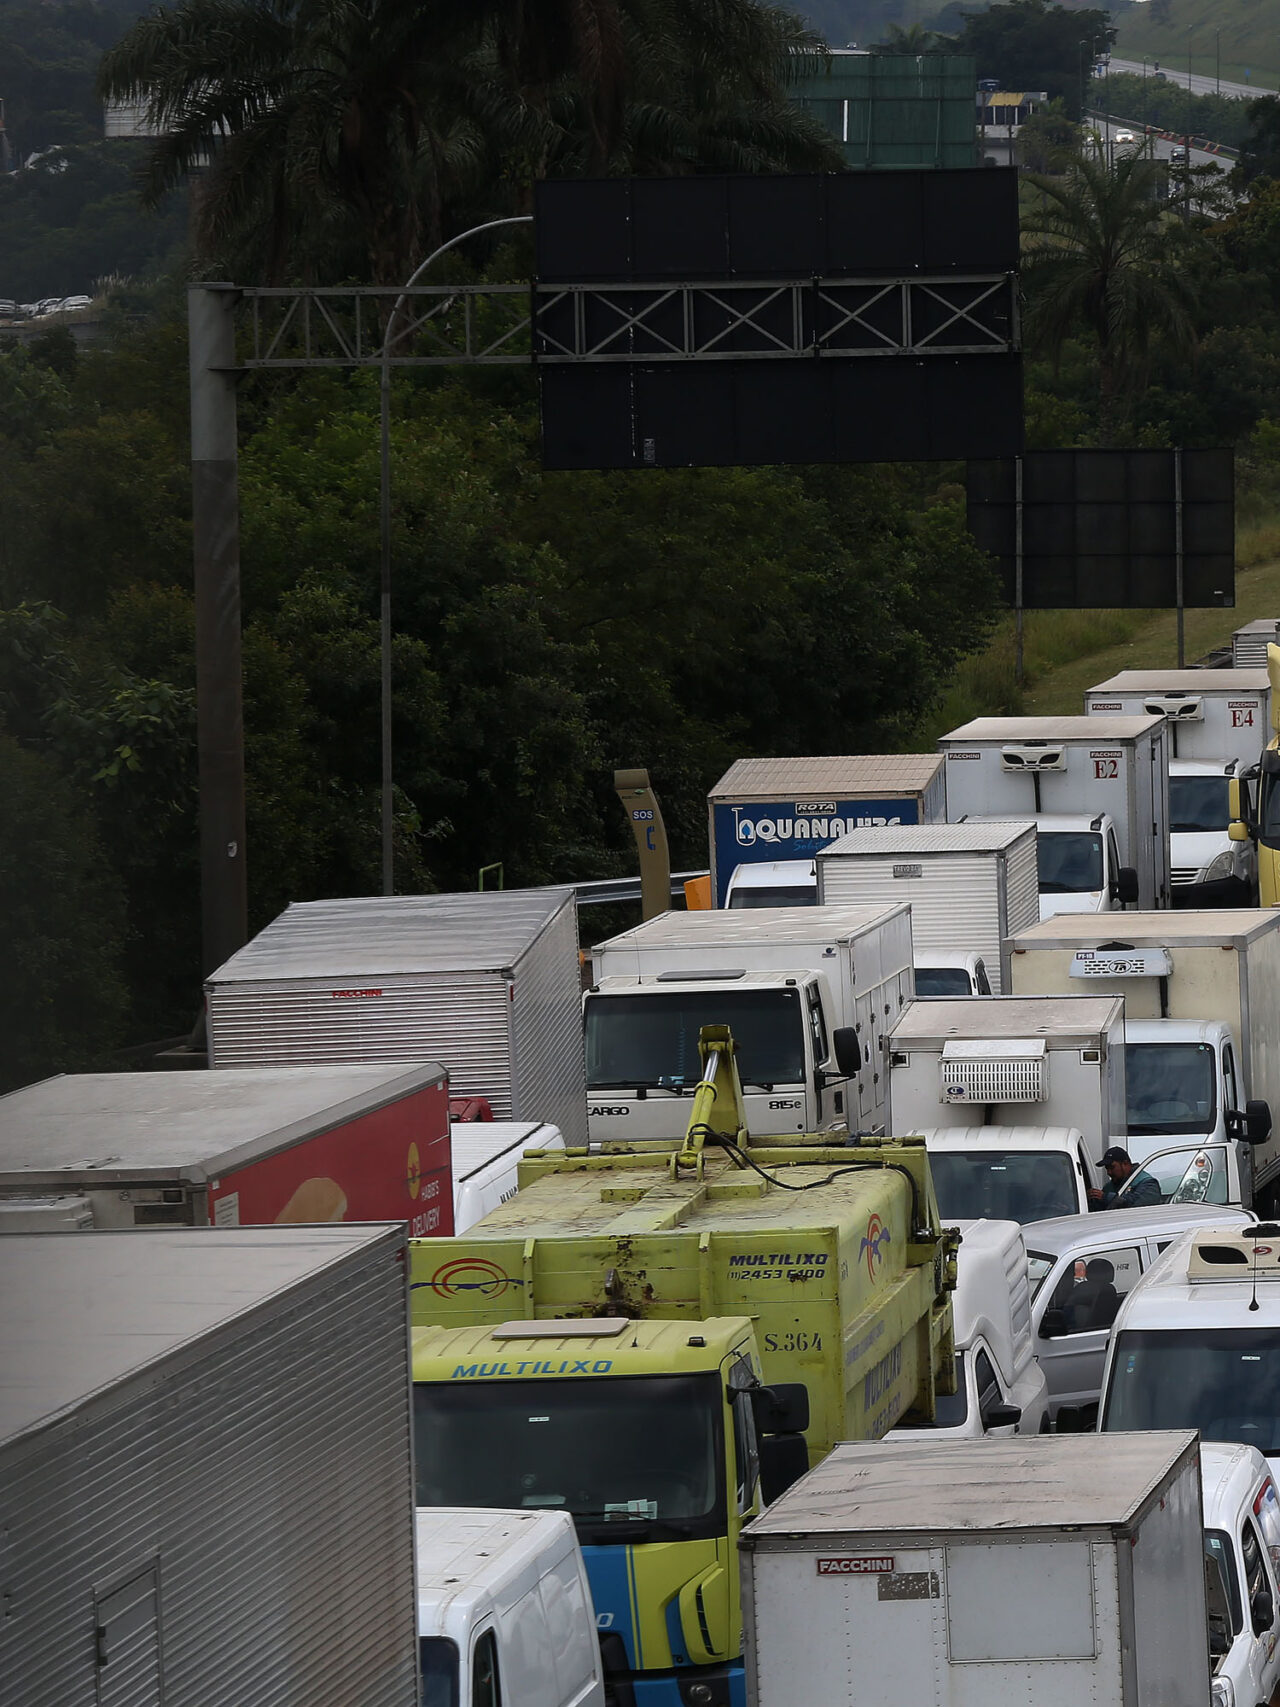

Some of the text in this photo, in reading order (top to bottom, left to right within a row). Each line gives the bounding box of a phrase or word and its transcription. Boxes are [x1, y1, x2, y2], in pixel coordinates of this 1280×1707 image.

[1231, 709, 1254, 727] E4
[1094, 759, 1118, 779] E2
[798, 803, 835, 811] ROTA
[633, 810, 653, 819] SOS
[587, 1106, 630, 1116] CARGO
[729, 1254, 829, 1266] MULTILIXO
[451, 1360, 614, 1379] MULTILIXO
[819, 1559, 893, 1572] FACCHINI
